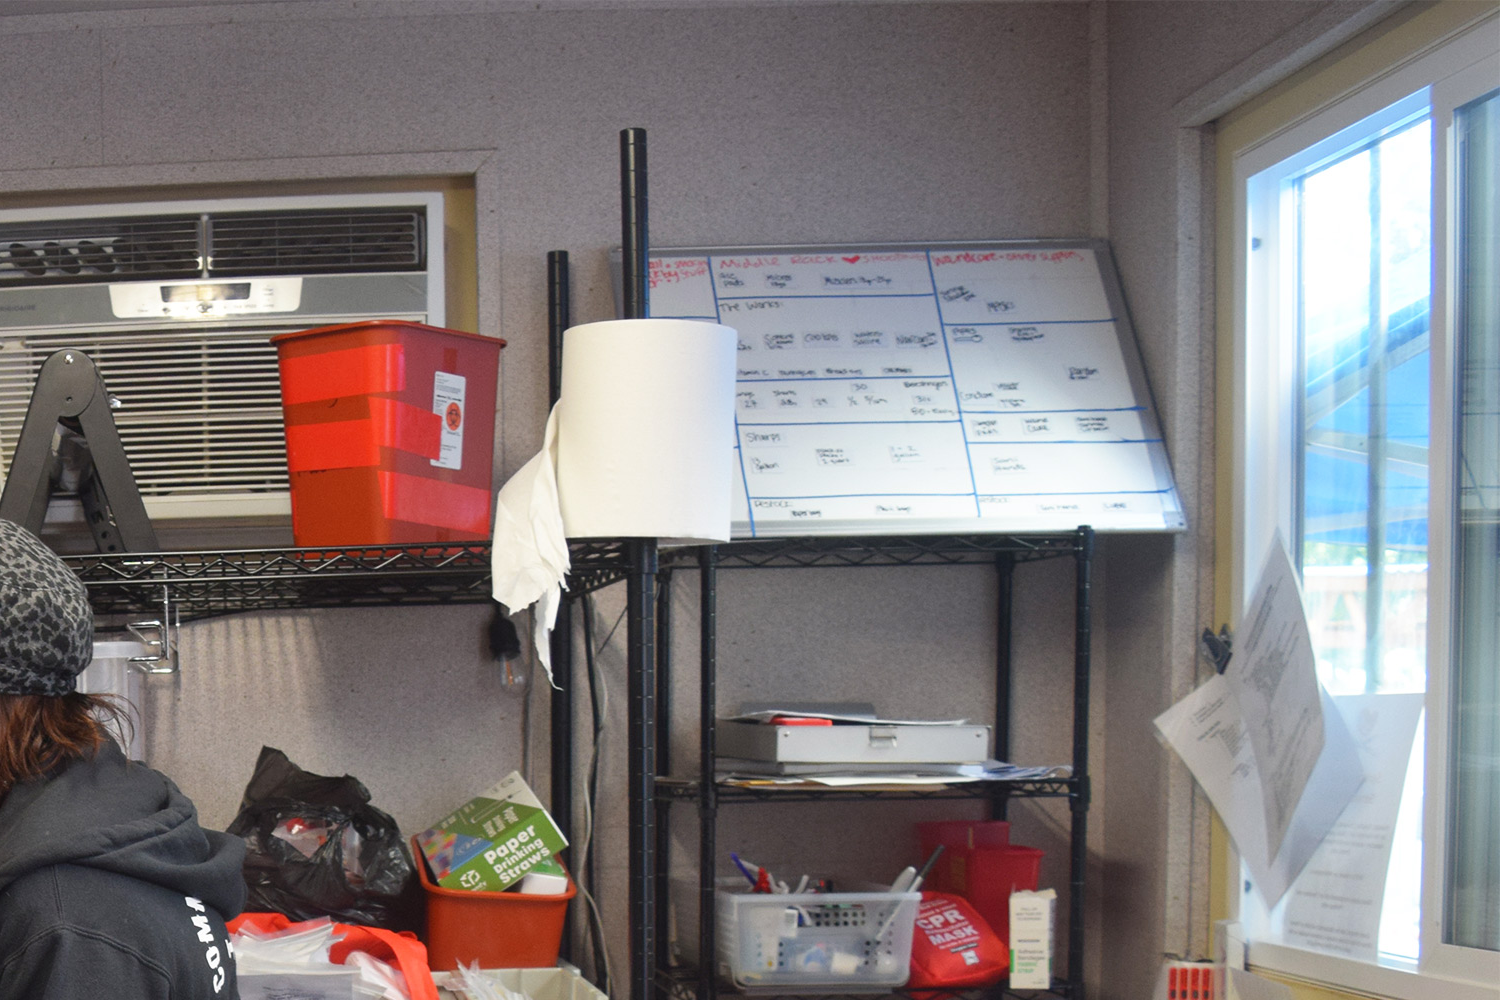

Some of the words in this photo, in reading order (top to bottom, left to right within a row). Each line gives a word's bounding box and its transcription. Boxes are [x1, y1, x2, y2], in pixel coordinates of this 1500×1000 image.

[483, 824, 537, 865] Paper
[493, 838, 544, 874] Drinking
[498, 847, 551, 884] Straws
[916, 909, 966, 930] CPR
[928, 925, 978, 946] MASK
